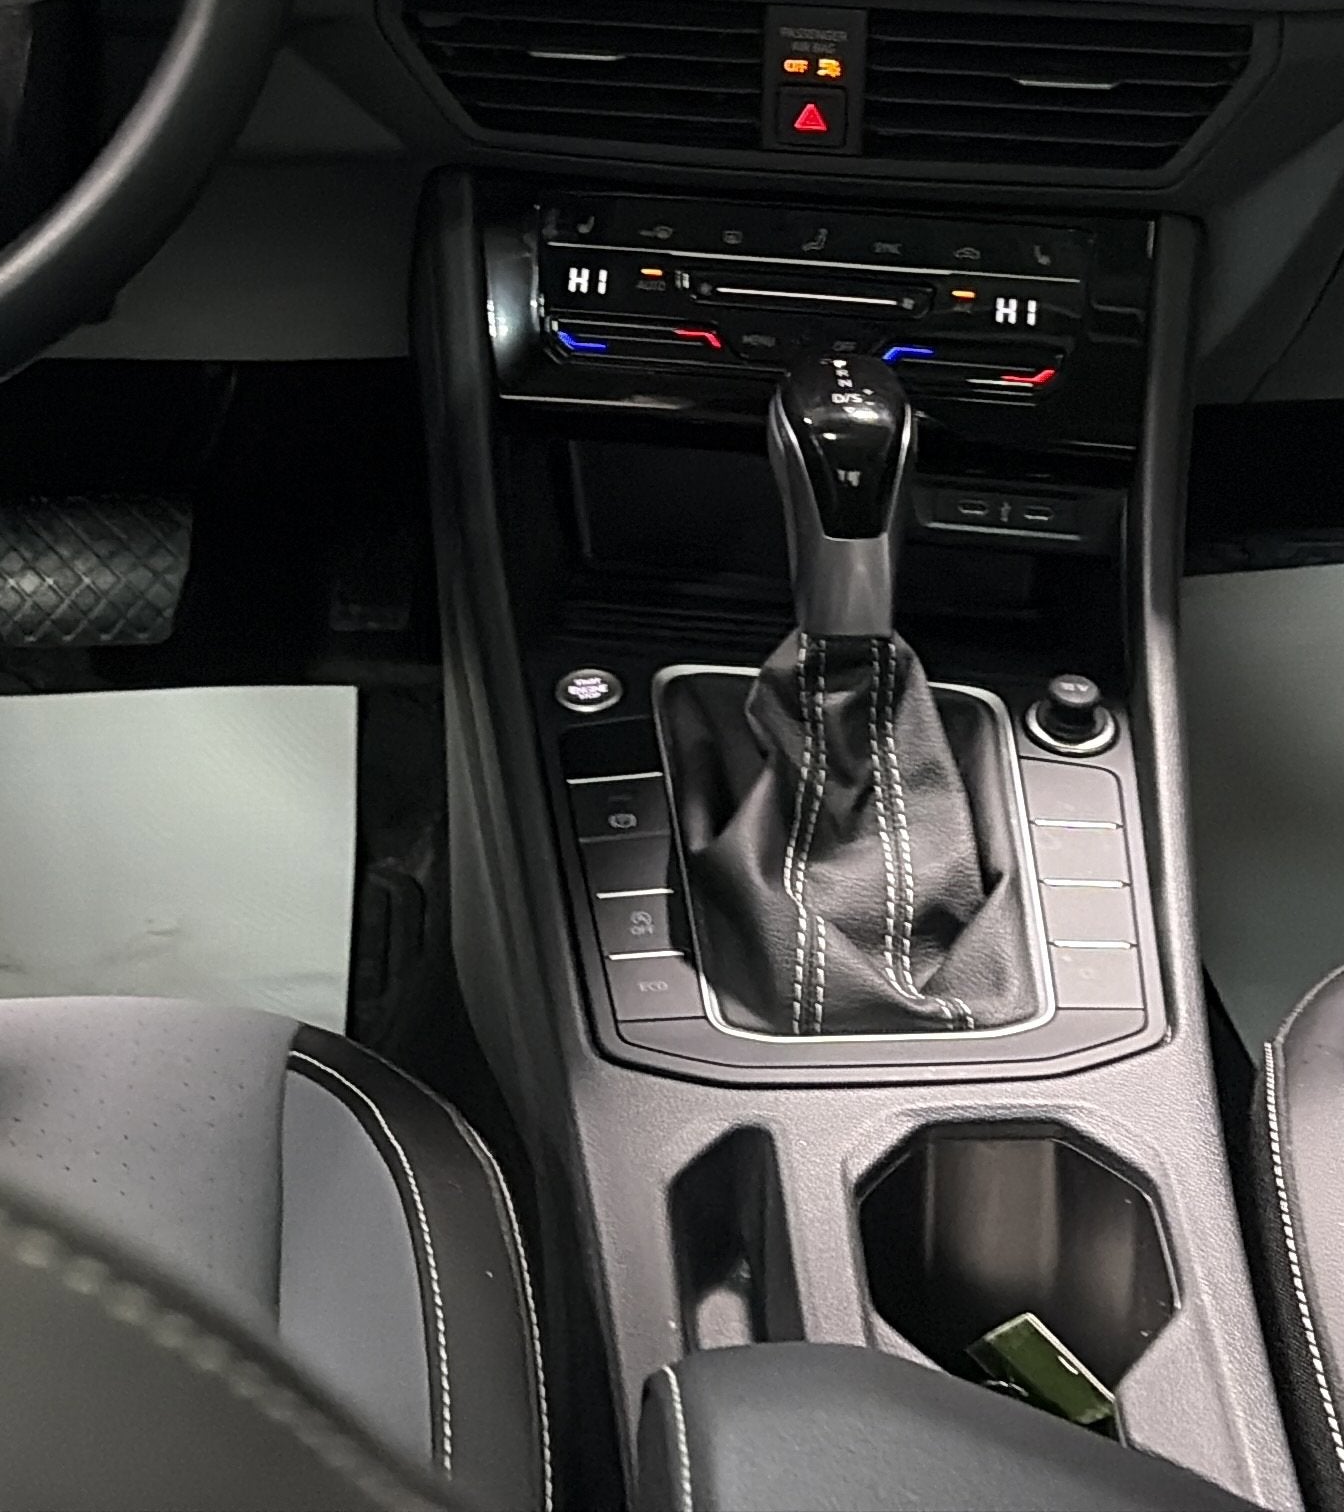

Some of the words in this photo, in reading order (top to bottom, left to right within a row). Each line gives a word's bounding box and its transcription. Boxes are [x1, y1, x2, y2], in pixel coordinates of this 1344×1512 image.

[783, 59, 809, 73] OFF
[567, 267, 608, 295] HI
[994, 297, 1038, 326] HI
